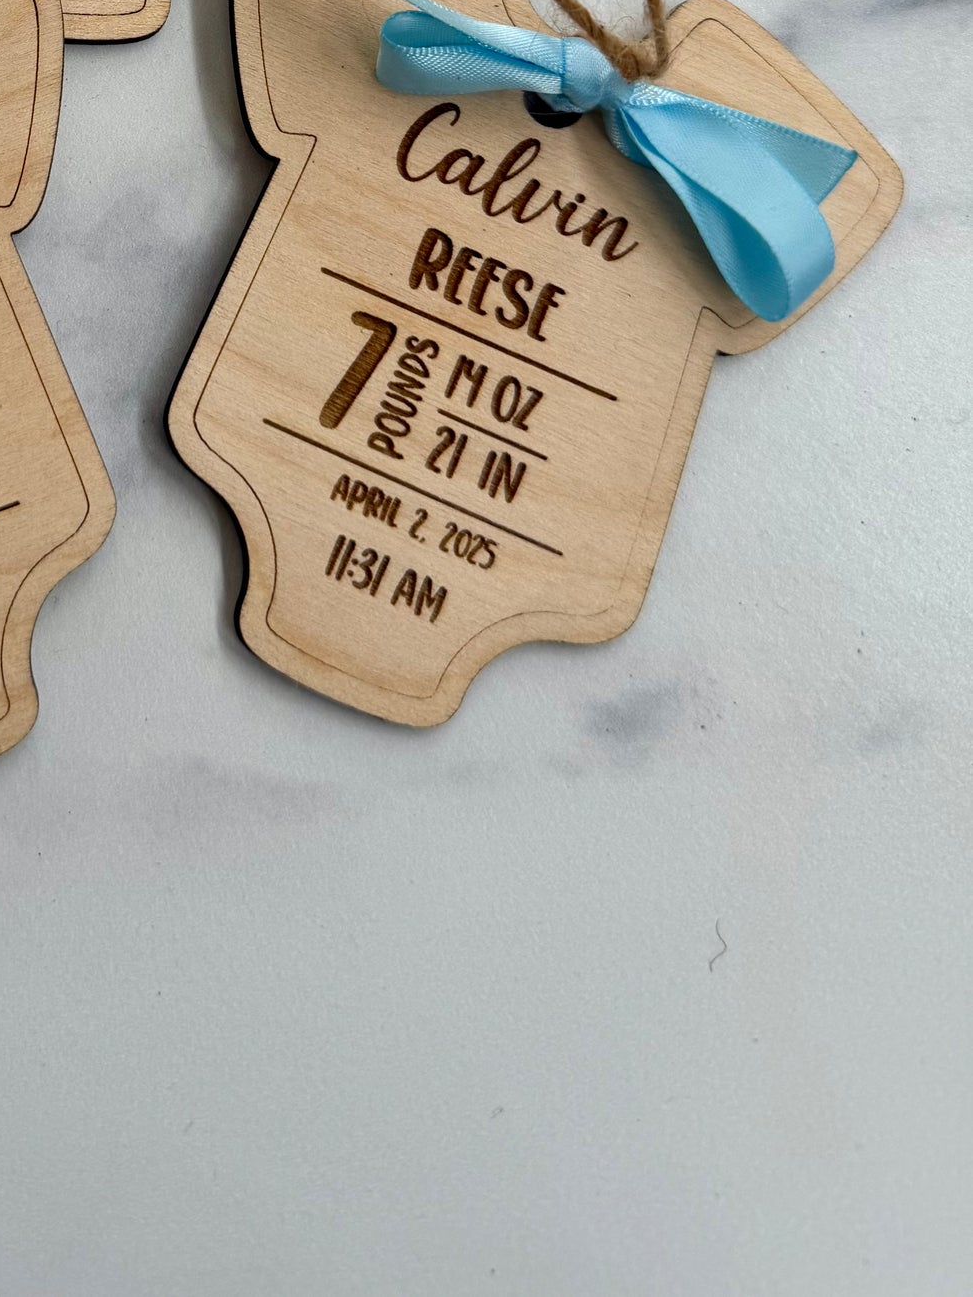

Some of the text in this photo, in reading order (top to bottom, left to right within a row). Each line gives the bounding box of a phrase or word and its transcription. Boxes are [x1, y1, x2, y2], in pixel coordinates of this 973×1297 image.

[396, 102, 638, 262] Calvin
[409, 227, 566, 342] REESE
[319, 310, 398, 429] 7
[368, 334, 439, 460] POUNDS
[491, 375, 544, 432] OZ
[425, 426, 527, 503] 21 IN
[330, 474, 402, 528] APRIL
[439, 522, 500, 570] 2025
[325, 534, 448, 623] 11:31 AM
